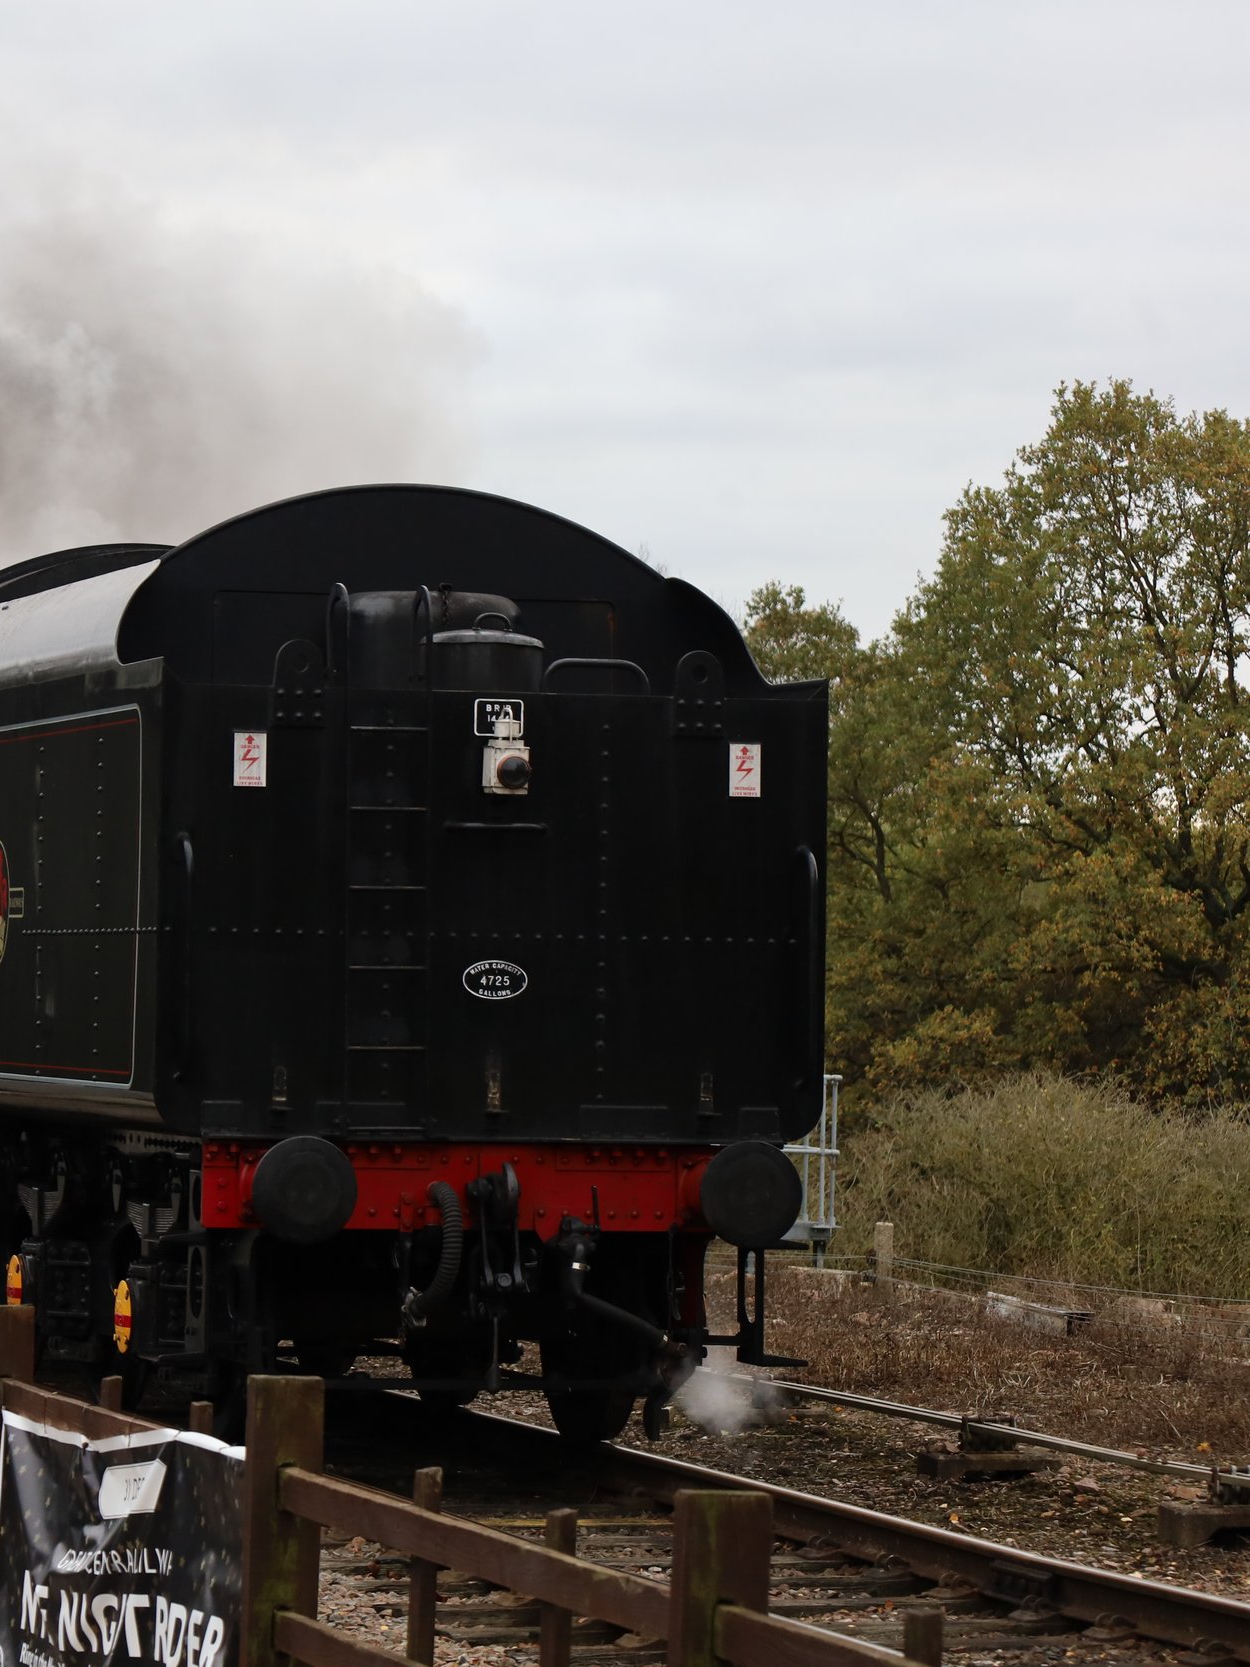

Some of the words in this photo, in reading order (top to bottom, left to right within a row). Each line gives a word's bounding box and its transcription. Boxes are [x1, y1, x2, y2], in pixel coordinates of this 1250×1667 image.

[470, 963, 490, 975] WATER
[492, 963, 521, 976] CAPACITY
[480, 975, 510, 986] 4725
[478, 988, 511, 997] GALLONS
